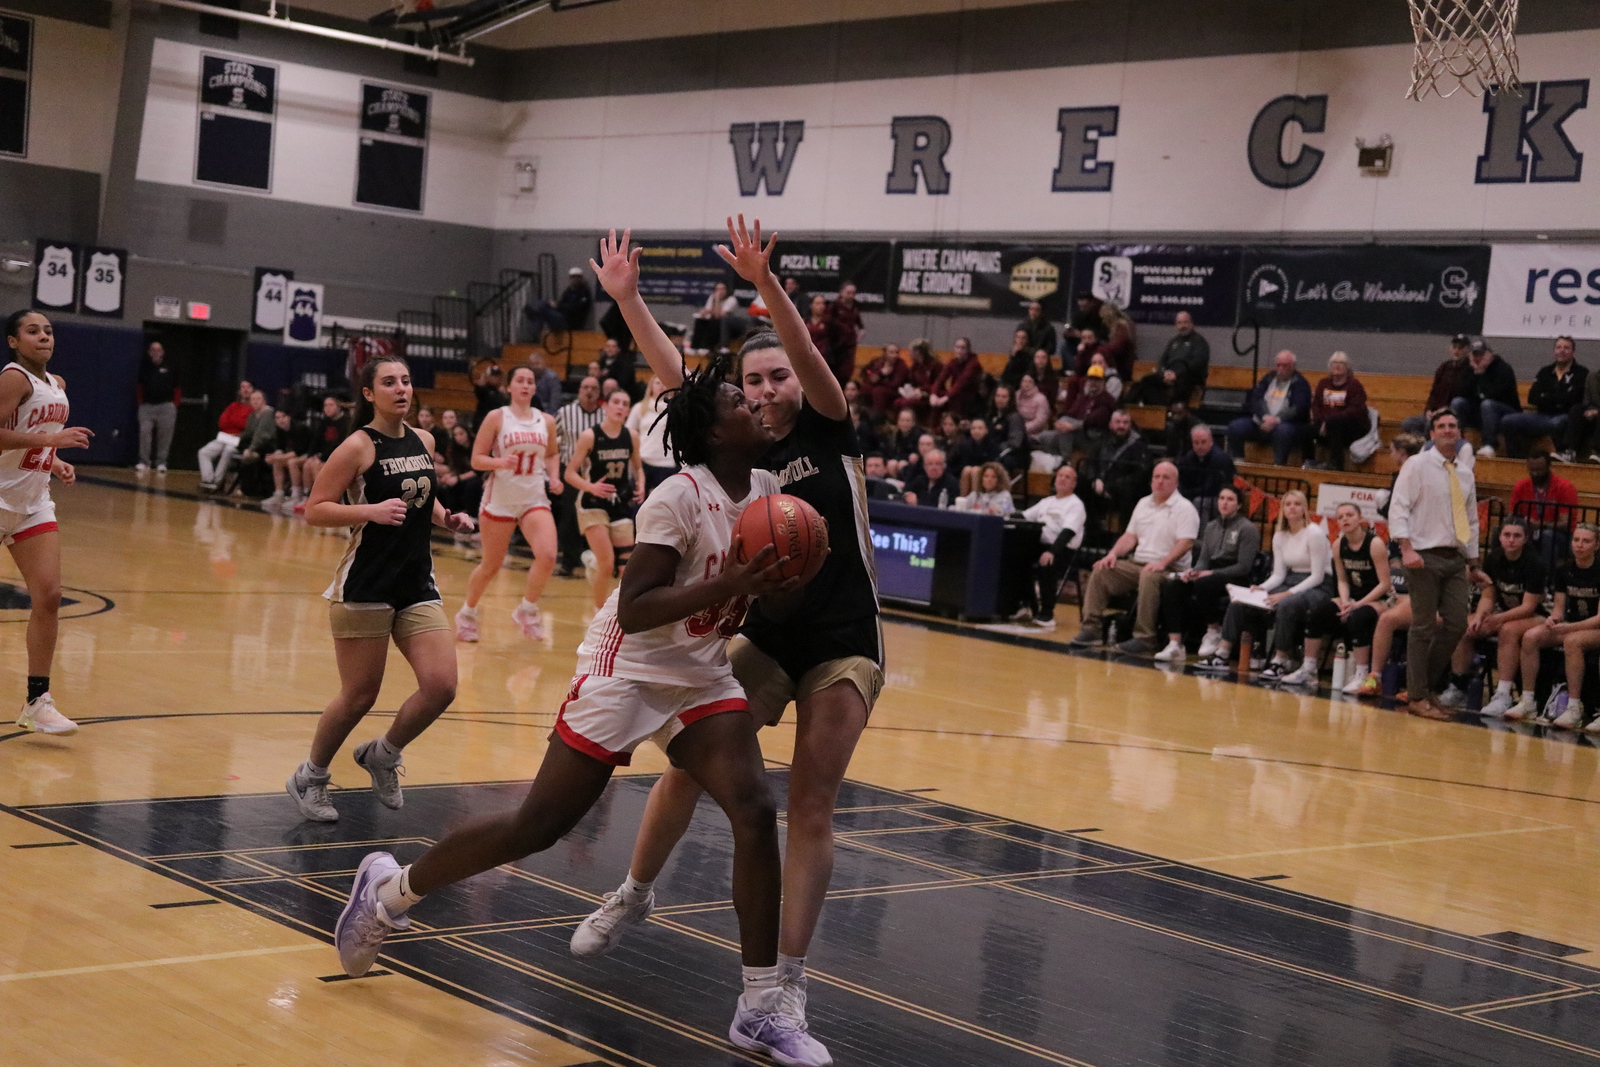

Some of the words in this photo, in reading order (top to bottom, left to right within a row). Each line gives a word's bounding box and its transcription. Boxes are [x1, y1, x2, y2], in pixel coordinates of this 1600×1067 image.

[47, 262, 67, 277] 34
[780, 254, 812, 269] PIZZA
[940, 249, 1002, 273] CHAMPIONS
[1133, 265, 1183, 276] HOWARD
[94, 268, 115, 283] 35
[898, 271, 921, 293] ARE
[922, 272, 972, 295] GROOMED
[1143, 275, 1204, 286] INSURANCE
[1525, 268, 1600, 305] res
[264, 289, 283, 302] 44
[1294, 279, 1328, 301] Let's
[1331, 280, 1360, 302] Go
[513, 450, 538, 476] 11
[401, 476, 431, 509] 23
[892, 532, 928, 555] This?
